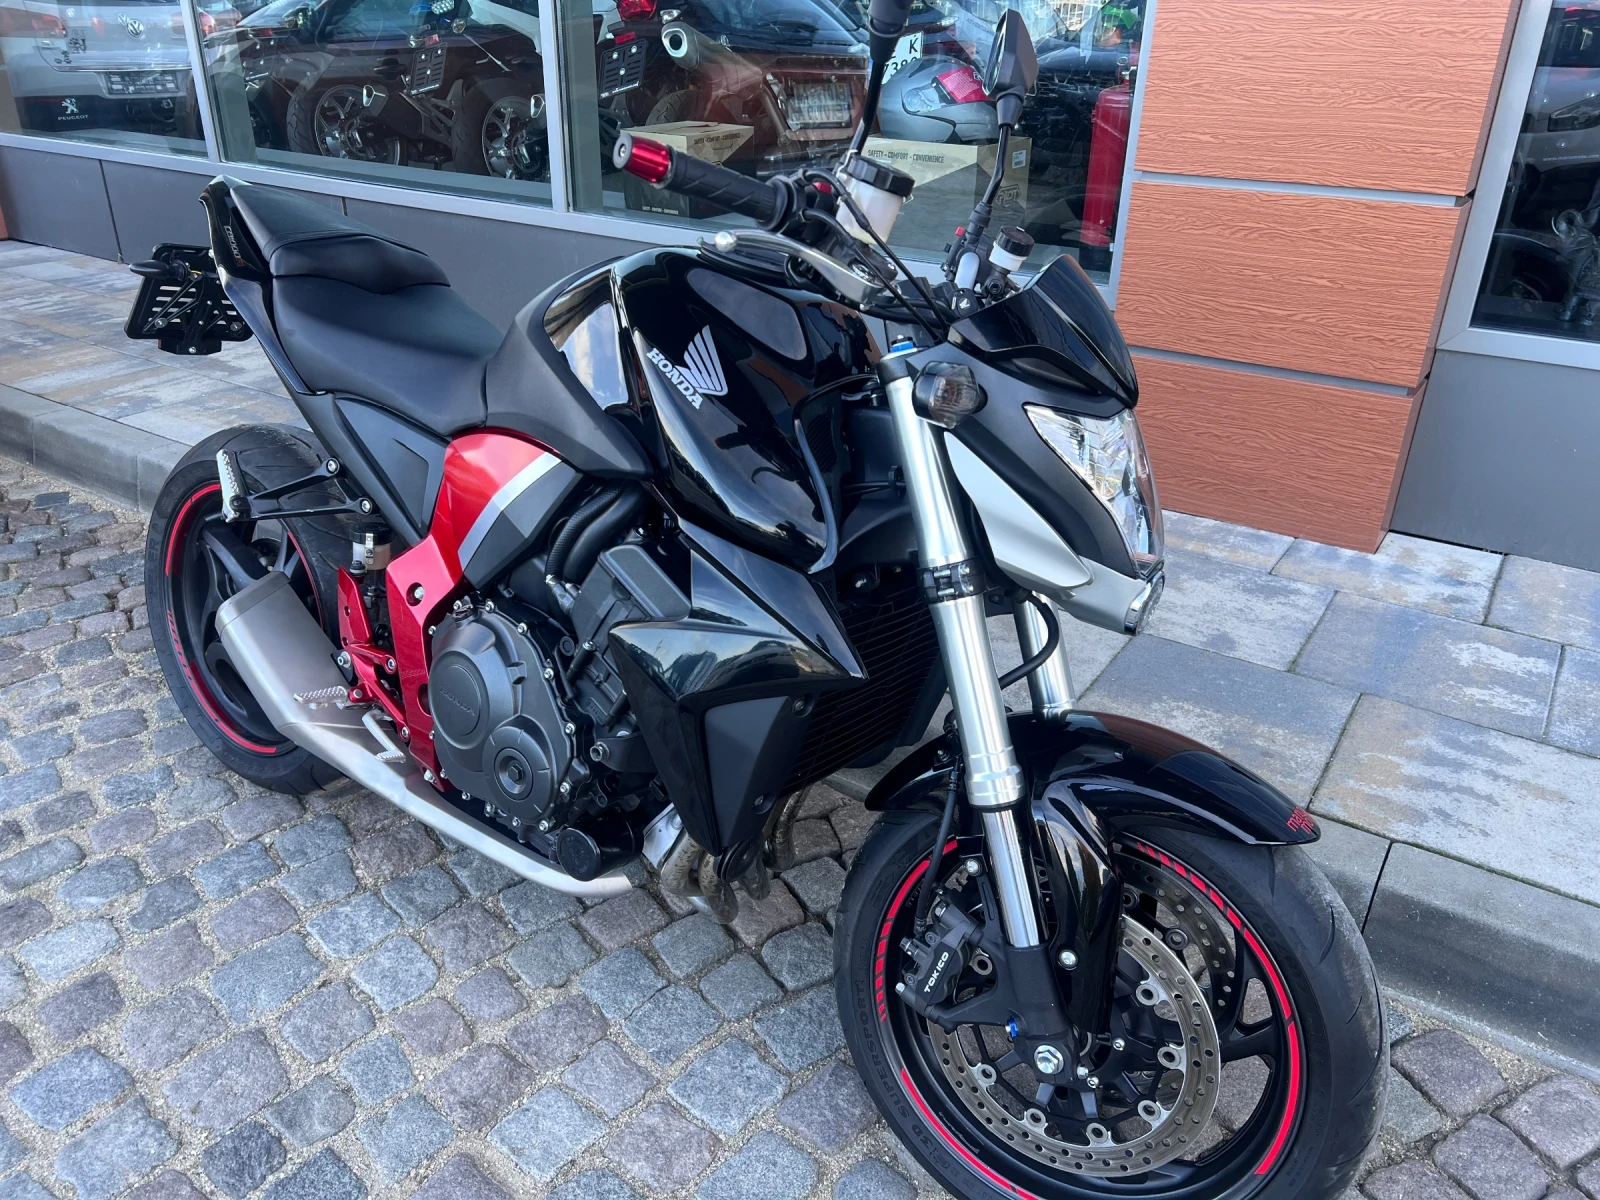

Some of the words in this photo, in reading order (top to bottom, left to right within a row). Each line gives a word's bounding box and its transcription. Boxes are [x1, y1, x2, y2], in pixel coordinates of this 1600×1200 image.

[868, 149, 884, 158] SAFETY
[888, 151, 909, 160] COMFORT
[912, 153, 945, 163] CONVENIENCE
[224, 225, 244, 267] CB1000R
[646, 347, 705, 410] HONDA
[923, 951, 949, 993] TOKICO
[855, 982, 910, 1119] SUPERSPORT
